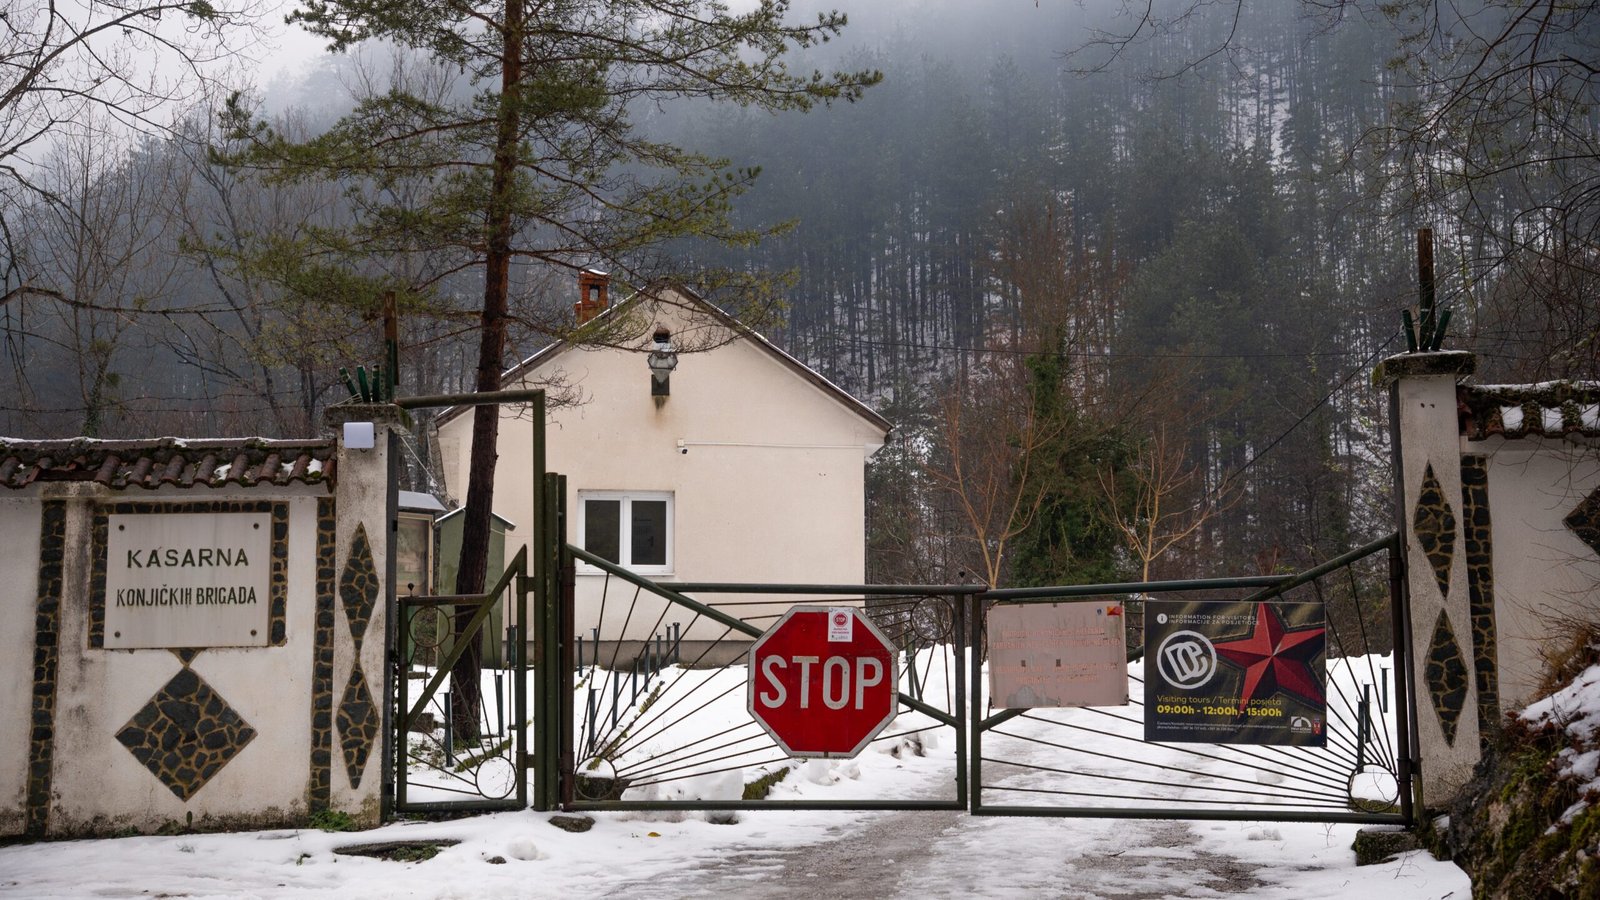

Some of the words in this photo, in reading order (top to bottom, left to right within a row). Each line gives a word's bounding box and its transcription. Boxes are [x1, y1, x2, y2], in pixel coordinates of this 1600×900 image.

[116, 584, 192, 607] KONJIČKIH
[196, 586, 257, 605] BRIGADA
[759, 654, 884, 711] STOP
[1157, 695, 1187, 704] Visiting
[1189, 696, 1210, 704] tours
[1218, 696, 1248, 705] Termini
[1251, 698, 1282, 707] posjeta
[1157, 705, 1194, 714] 09:00h
[1203, 706, 1238, 716] 12:00h
[1247, 707, 1282, 717] 15:00h
